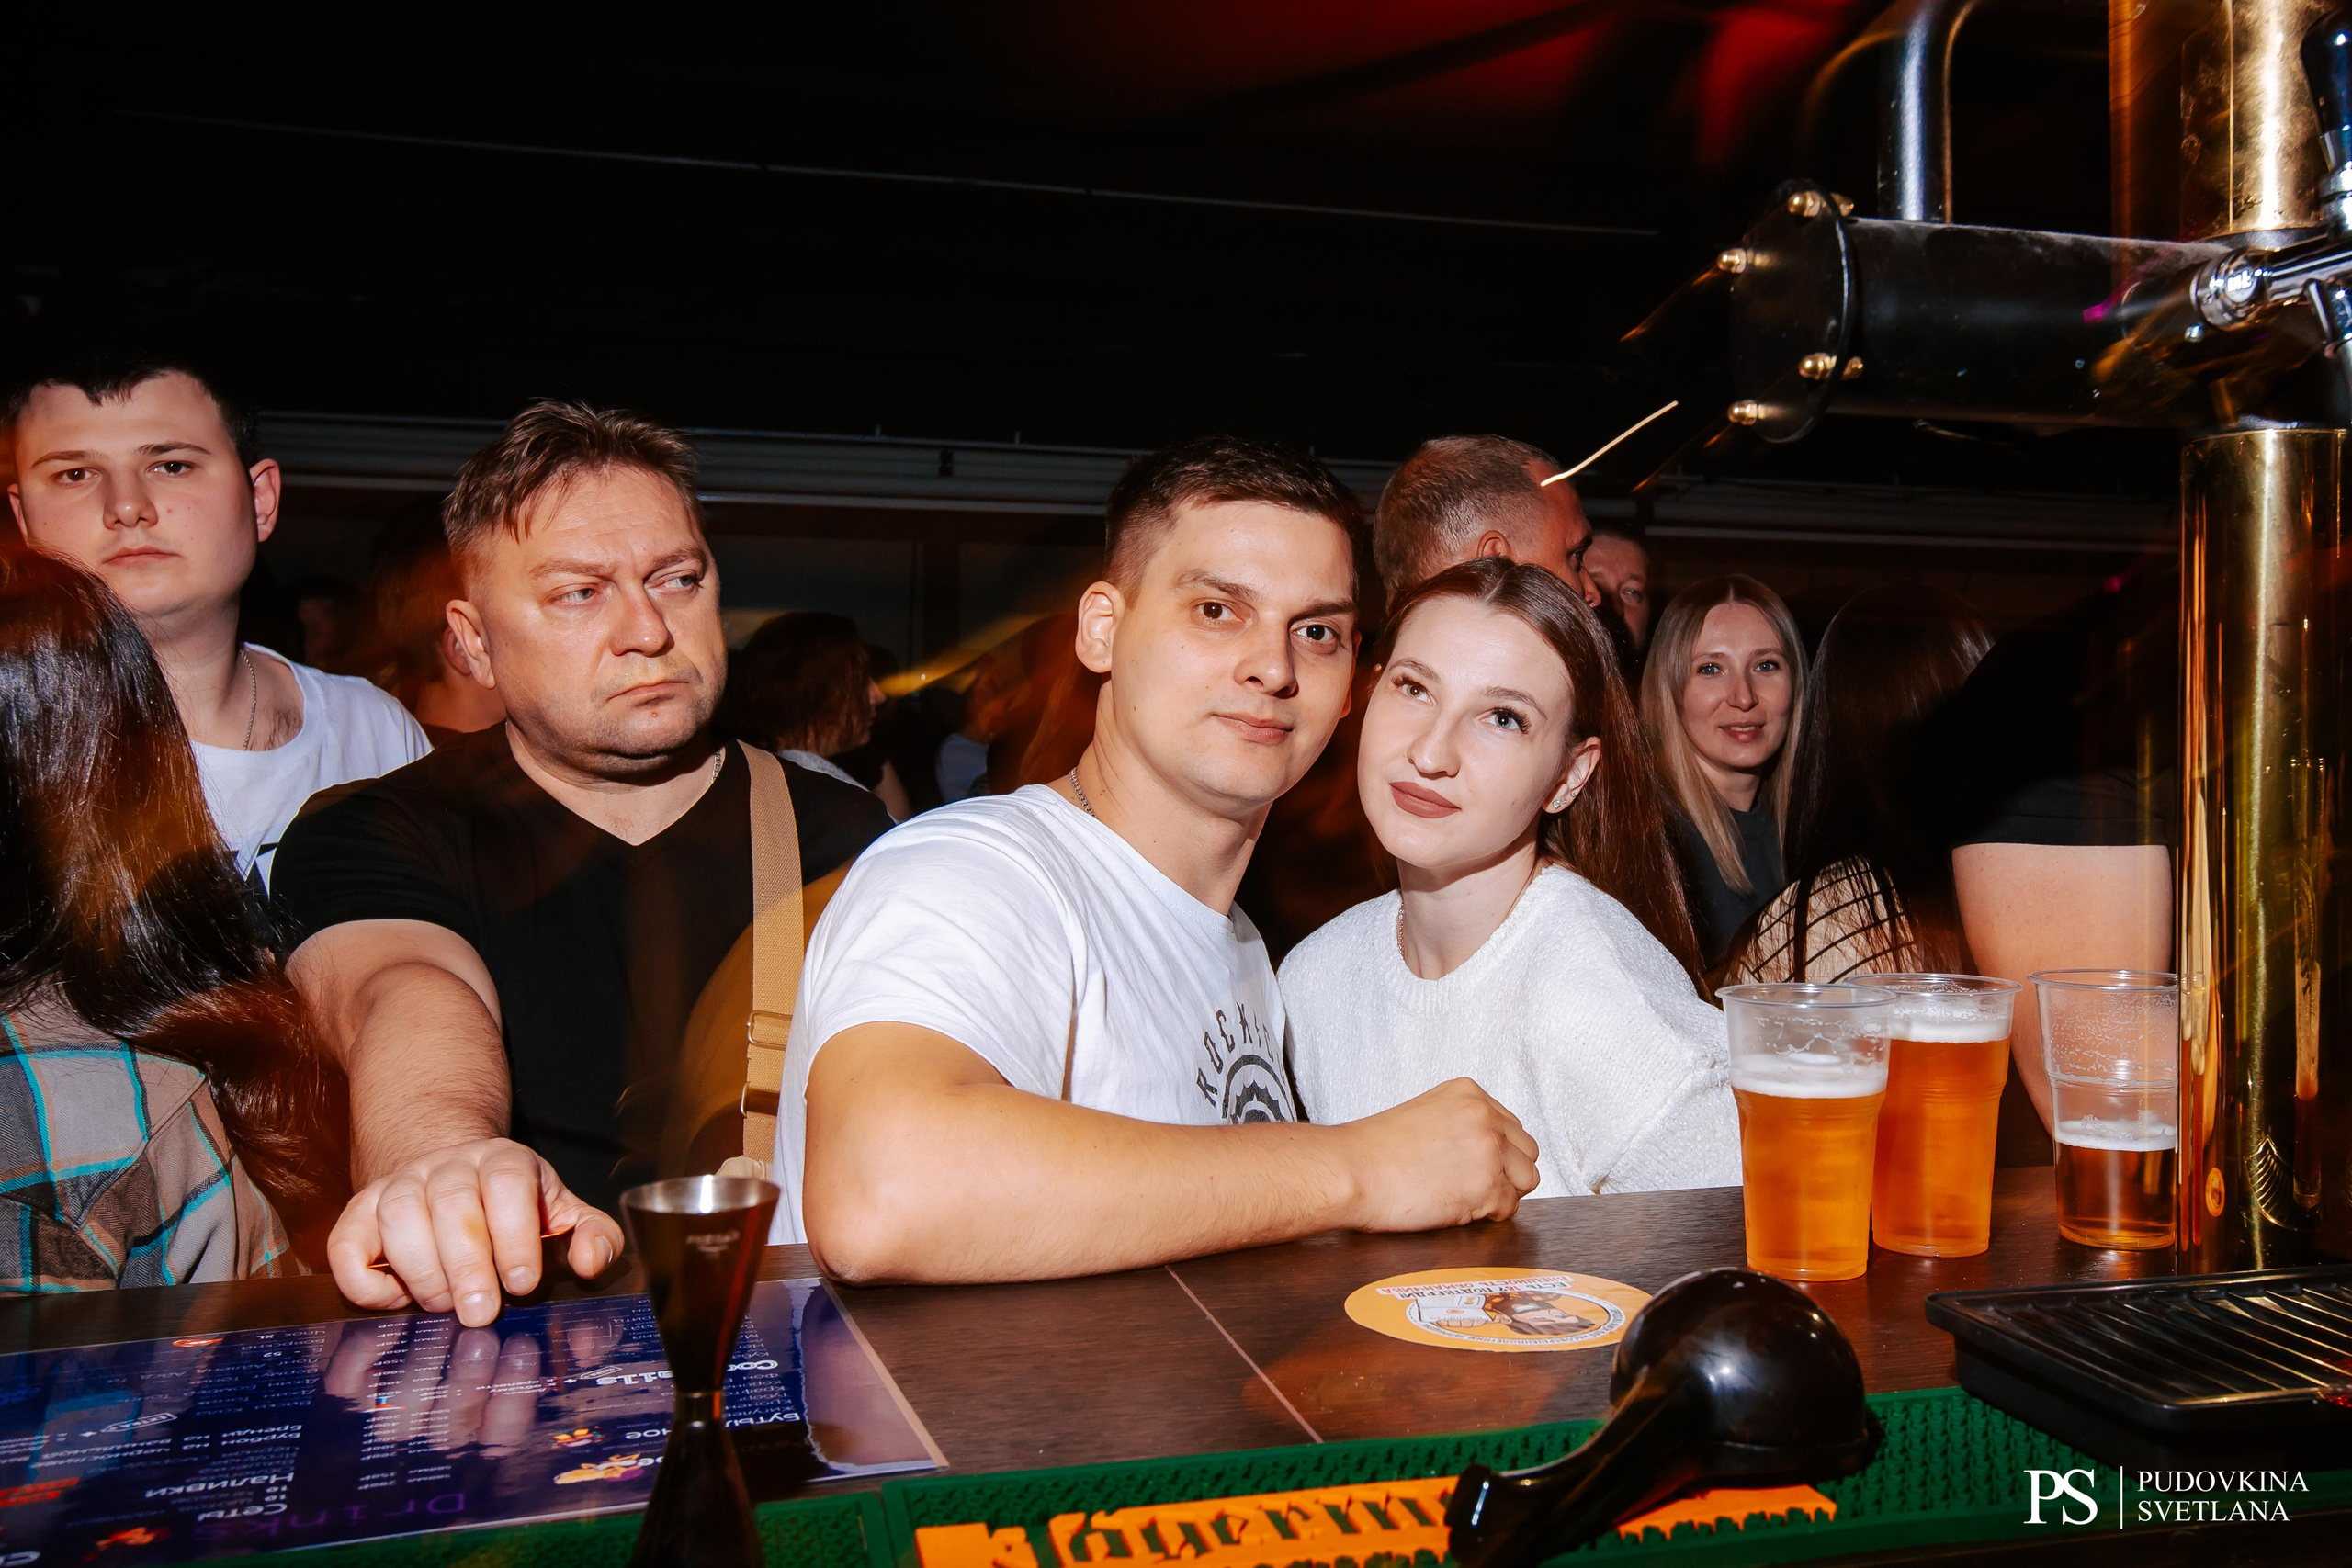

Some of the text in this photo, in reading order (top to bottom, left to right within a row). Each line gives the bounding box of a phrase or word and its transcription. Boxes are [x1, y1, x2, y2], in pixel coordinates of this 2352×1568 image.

[1381, 1275, 1568, 1295] ВНЕШНОСТЬ ОБМАНЧИВА
[1525, 1281, 1568, 1292] ЕСТЬ
[1399, 1286, 1494, 1300] ПОДТВЕРДИ!
[241, 1338, 325, 1351] Боярский
[595, 1359, 779, 1385] Cocails
[267, 1377, 320, 1387] Джин
[263, 1388, 317, 1398] Джин
[183, 1434, 211, 1442] на
[220, 1424, 303, 1438] Бренди
[182, 1442, 210, 1450] на
[220, 1432, 301, 1446] Бурбон
[144, 1472, 295, 1498] Наливки
[192, 1492, 466, 1541] Drinks
[195, 1502, 288, 1523] Сеты
